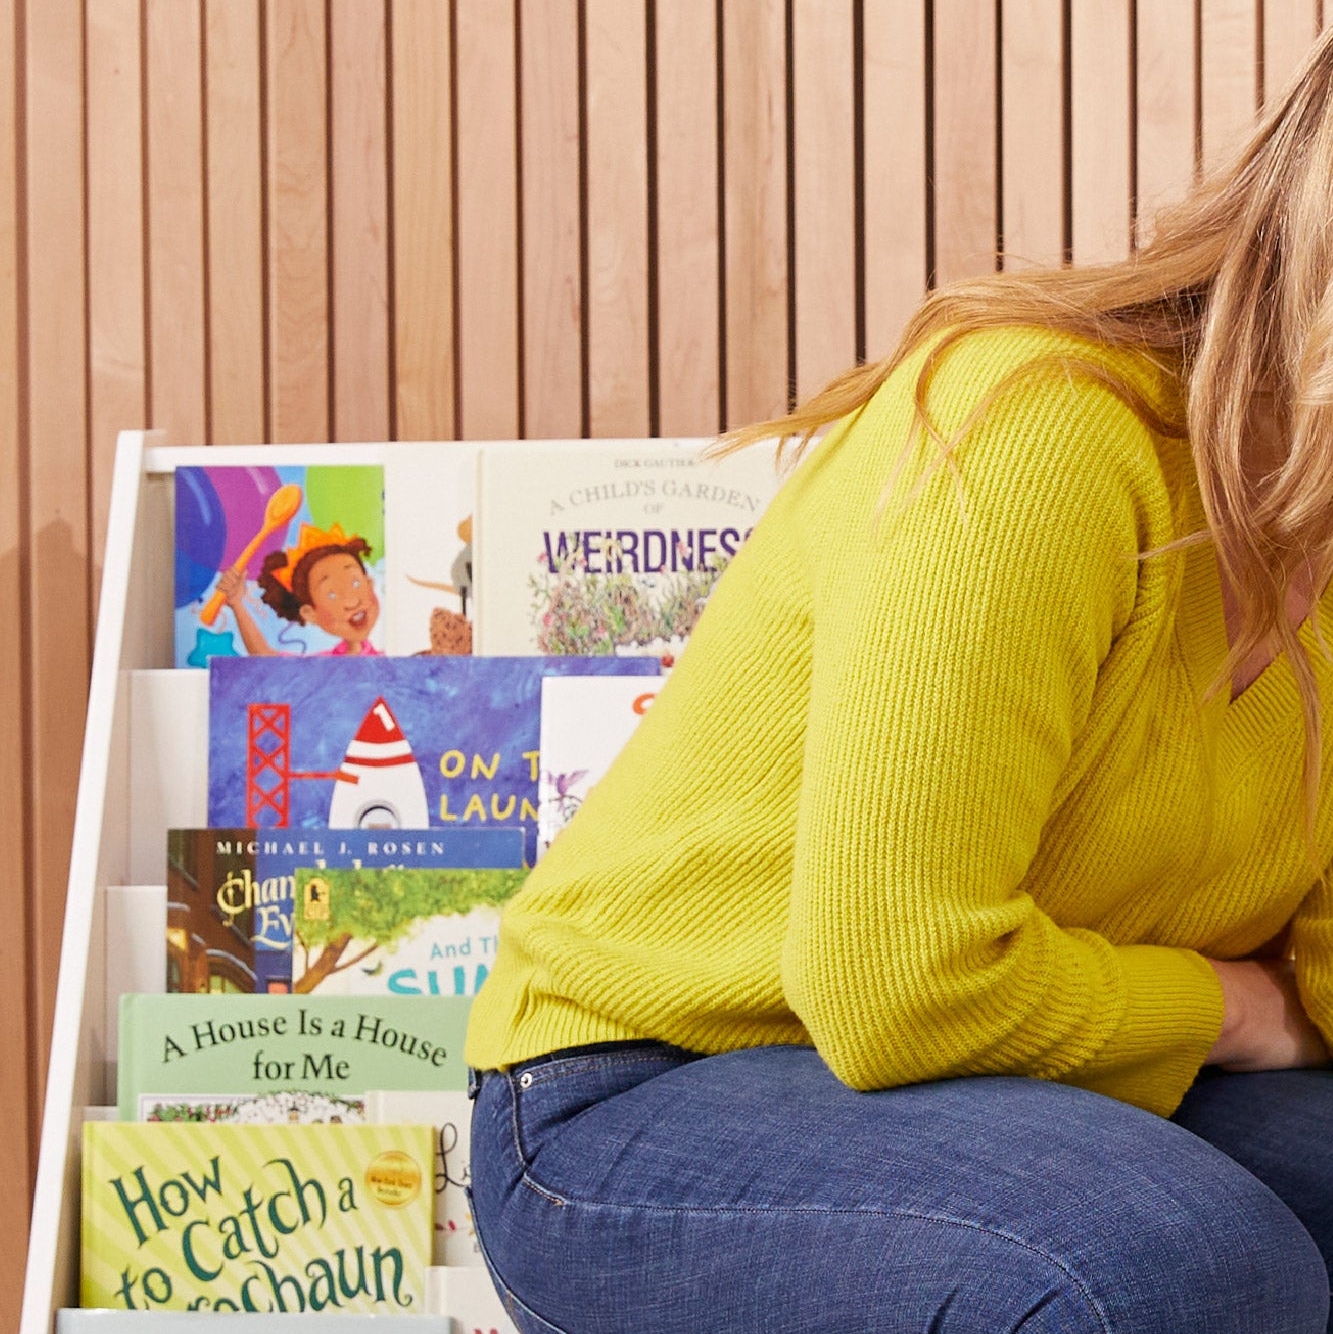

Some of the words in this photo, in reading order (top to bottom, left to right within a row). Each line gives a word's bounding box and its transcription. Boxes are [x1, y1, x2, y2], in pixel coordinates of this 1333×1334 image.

[549, 498, 565, 515] A
[661, 479, 761, 512] GARDEN
[440, 750, 500, 780] ON
[216, 841, 325, 855] MICHAEL
[339, 841, 353, 855] J.
[367, 841, 445, 855] ROSEN
[431, 936, 471, 960] And
[162, 1034, 187, 1063] A
[190, 1015, 288, 1049] House
[298, 1009, 322, 1036] Is
[330, 1019, 345, 1037] a
[353, 1013, 448, 1067] House
[252, 1049, 295, 1080] for
[301, 1053, 350, 1079] Me
[109, 1156, 222, 1248] How
[114, 1264, 172, 1311] to
[182, 1158, 328, 1282] Catch
[337, 1176, 360, 1213] a
